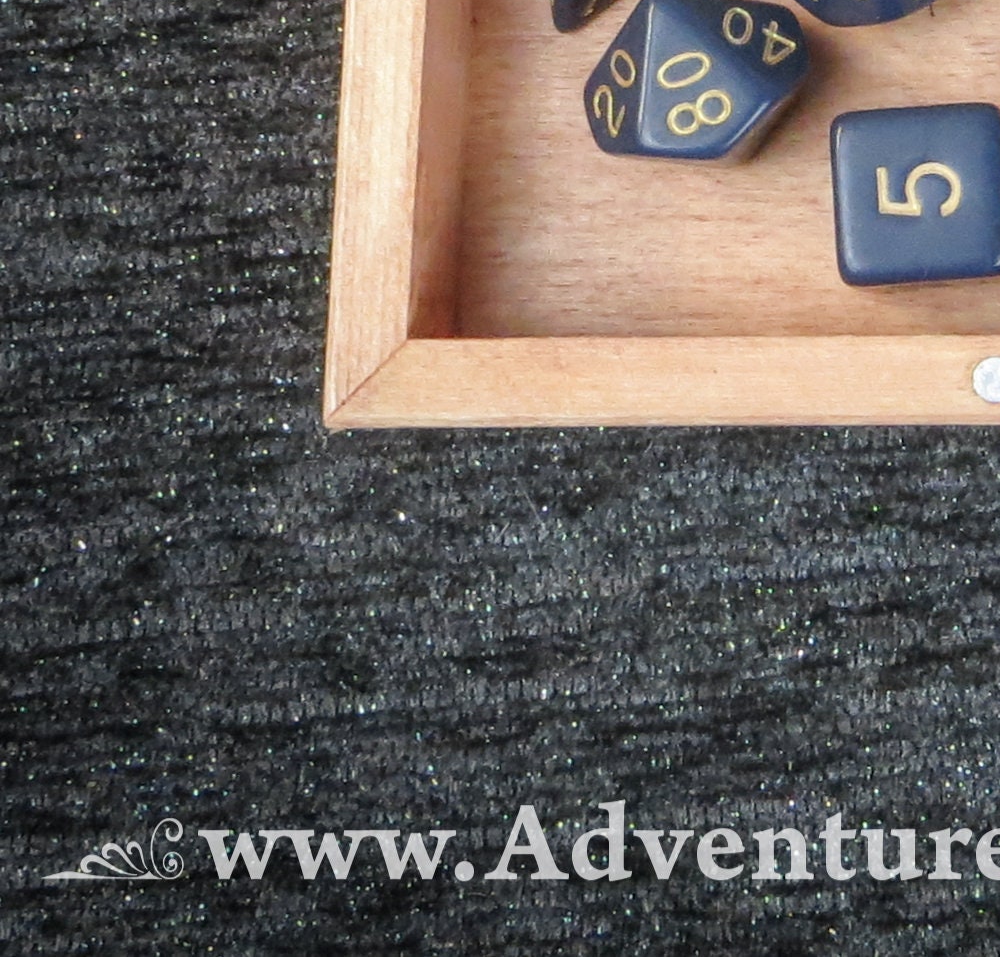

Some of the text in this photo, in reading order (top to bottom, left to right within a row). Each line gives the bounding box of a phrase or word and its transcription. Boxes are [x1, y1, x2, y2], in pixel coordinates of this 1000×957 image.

[592, 48, 637, 139] 20
[656, 50, 733, 136] 80
[875, 161, 962, 219] 5
